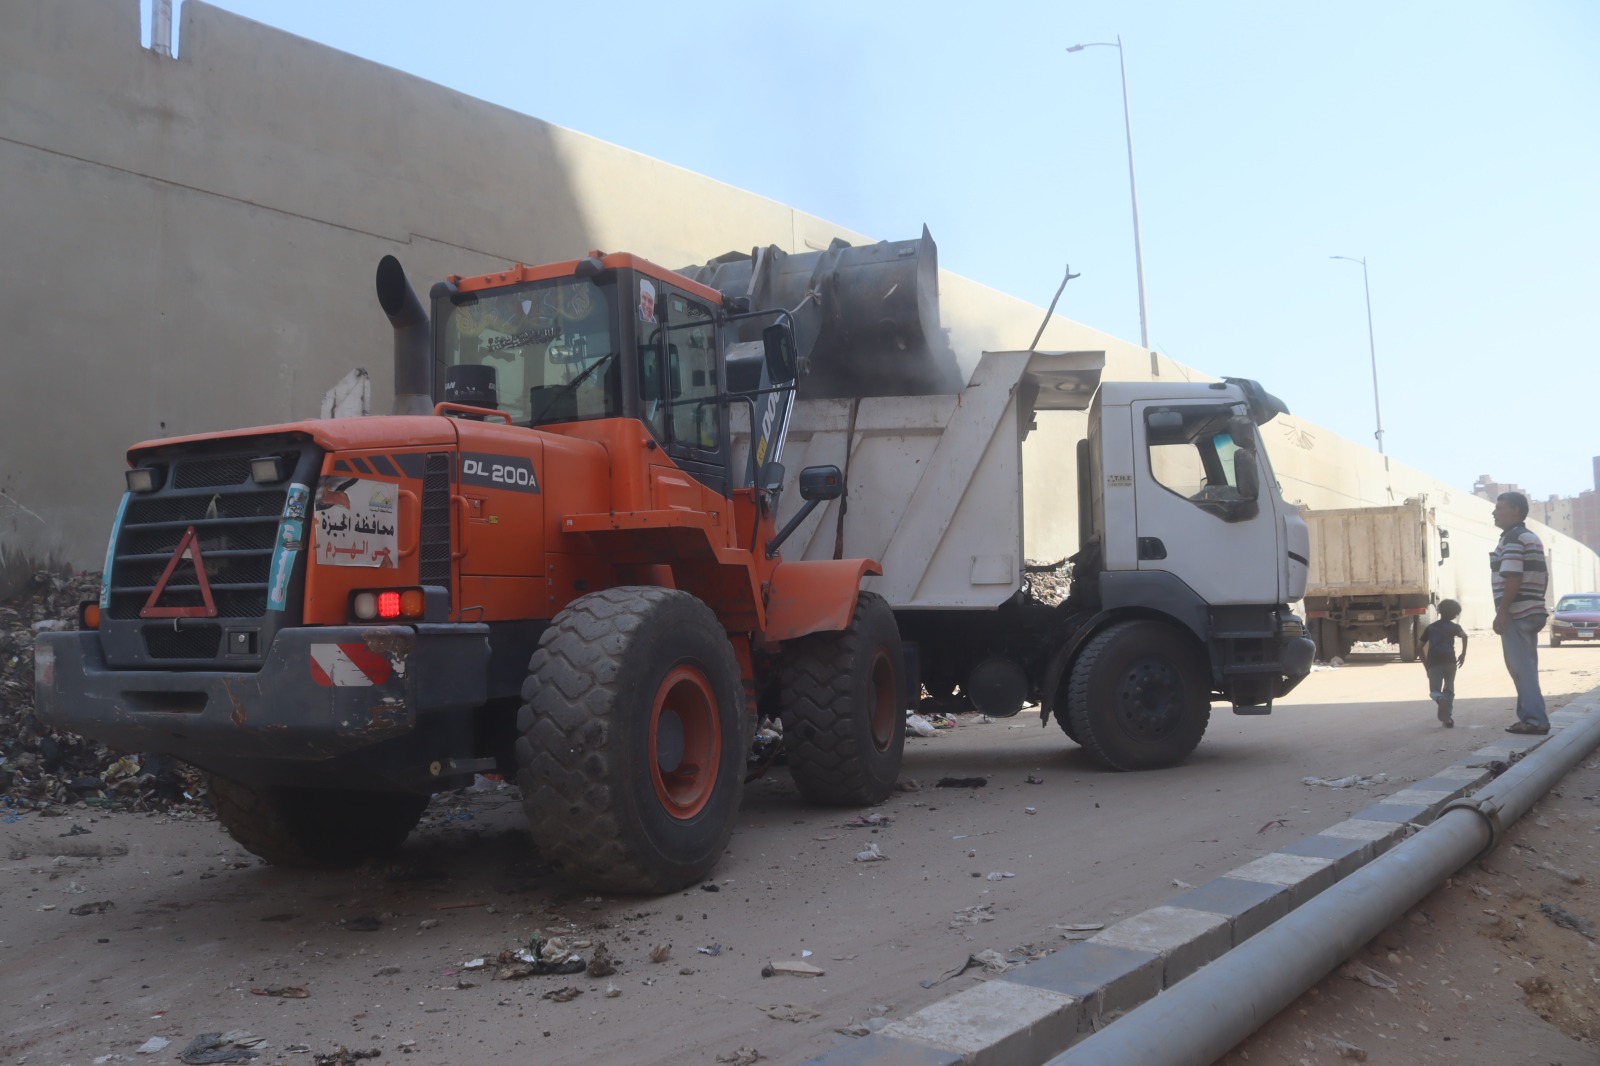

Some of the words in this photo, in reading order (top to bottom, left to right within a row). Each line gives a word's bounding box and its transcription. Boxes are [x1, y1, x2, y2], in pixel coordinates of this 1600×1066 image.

[463, 459, 489, 477] DL
[321, 511, 351, 538] الجيزة
[354, 512, 395, 537] محافظة
